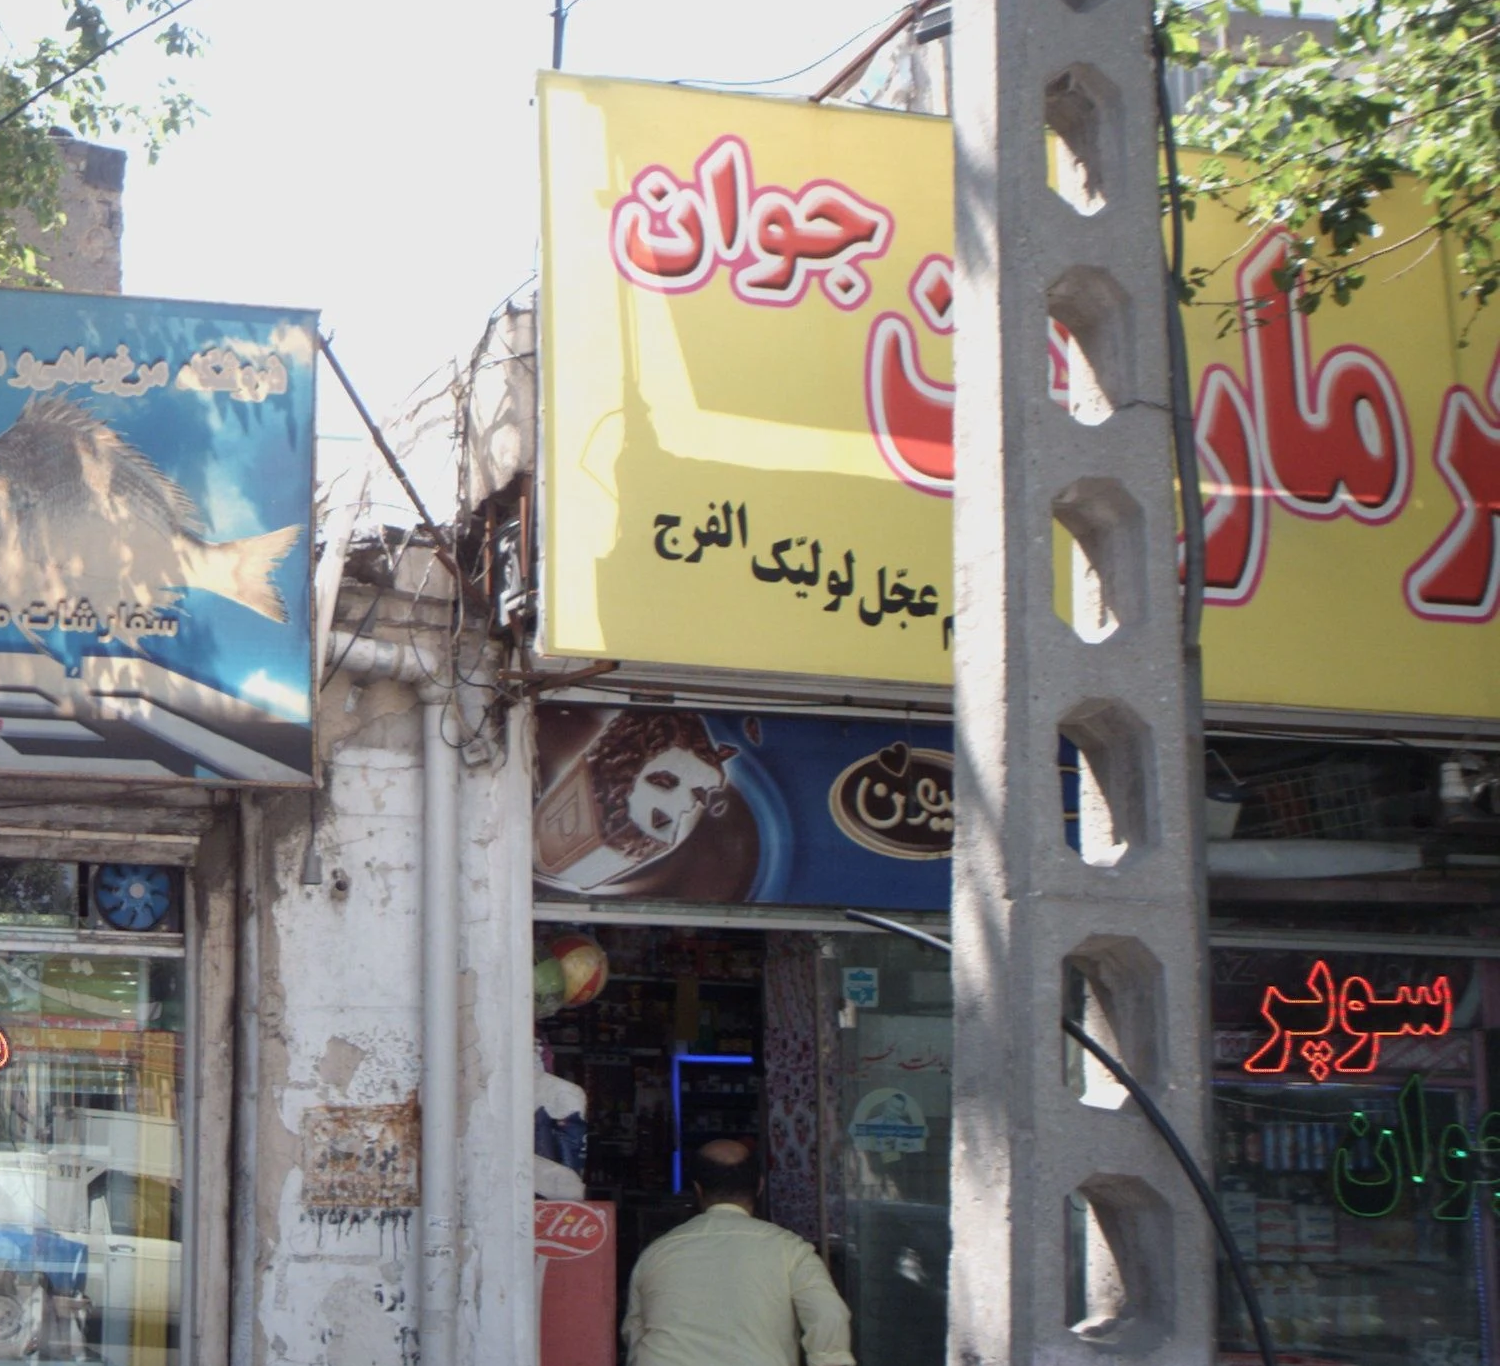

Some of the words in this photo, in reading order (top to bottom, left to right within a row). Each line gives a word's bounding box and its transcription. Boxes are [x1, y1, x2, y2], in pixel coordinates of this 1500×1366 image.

[610, 134, 895, 310] جوان
[652, 499, 749, 564] الفرج
[21, 595, 180, 644] سفارشات
[1244, 959, 1452, 1082] سوپر
